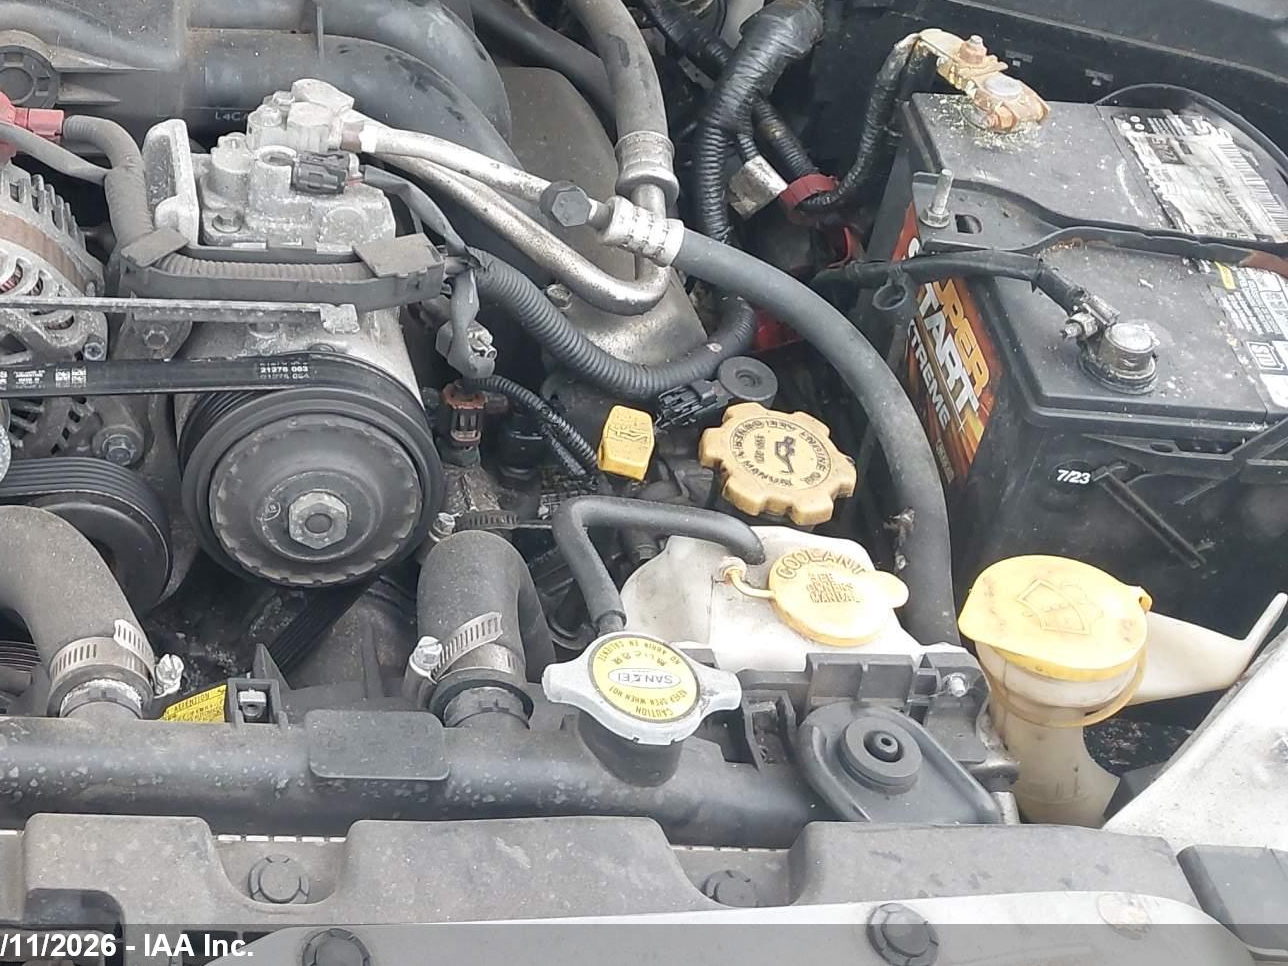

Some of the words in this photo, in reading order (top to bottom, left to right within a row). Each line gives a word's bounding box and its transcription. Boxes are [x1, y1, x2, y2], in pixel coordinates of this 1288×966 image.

[917, 282, 980, 412] TART
[908, 318, 951, 429] TREME
[1056, 469, 1092, 485] 7/23
[775, 548, 867, 580] COOLANT
[635, 705, 675, 718] CAUTION
